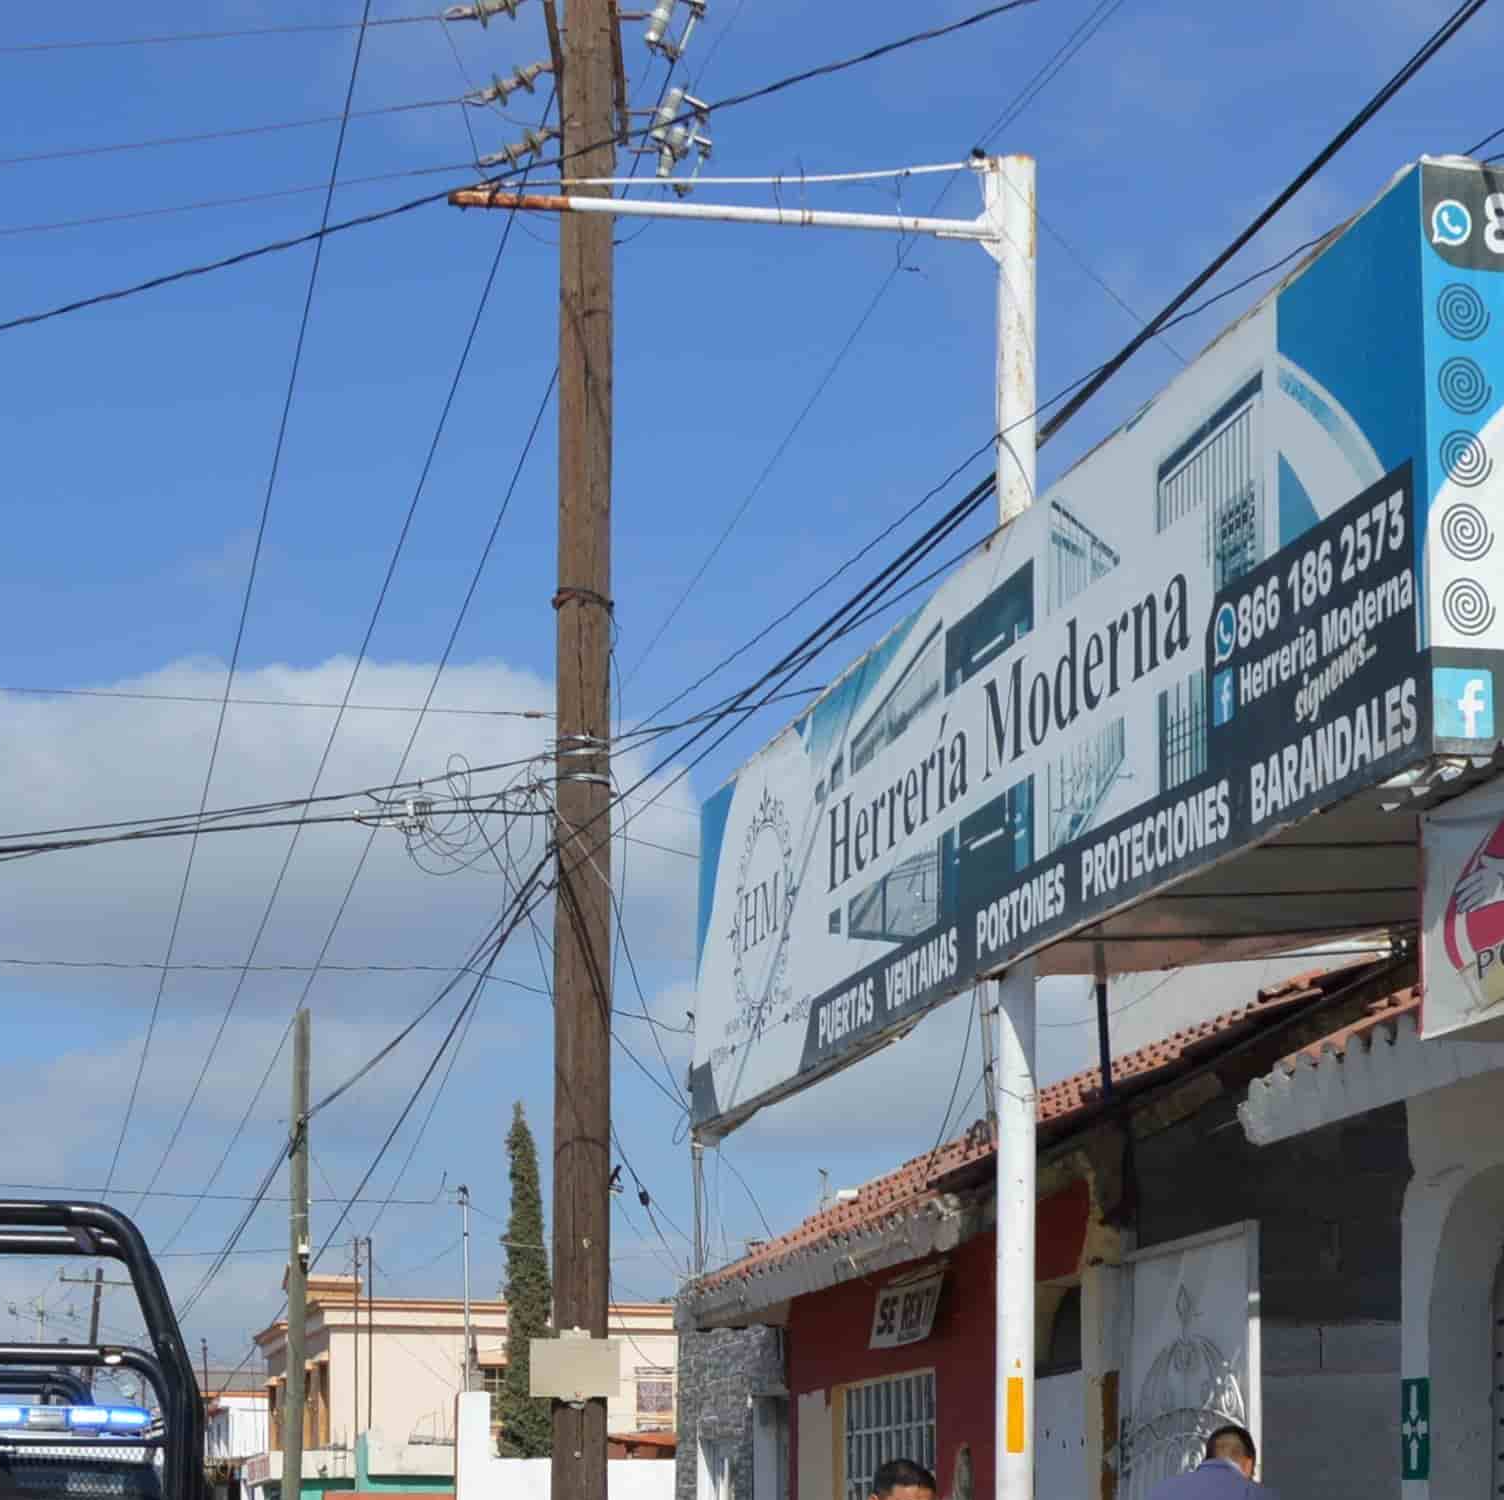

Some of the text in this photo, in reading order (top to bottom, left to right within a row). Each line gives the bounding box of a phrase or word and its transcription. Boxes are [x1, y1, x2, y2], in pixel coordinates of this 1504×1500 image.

[1237, 488, 1405, 649] 866 186 2573
[1321, 568, 1413, 657] Moderna
[825, 572, 1191, 894] Herrería Moderna
[742, 870, 780, 953] HM
[818, 676, 1418, 1049] PUERTAS VENTANAS PORTONES PROTECCIONES BARANDALES
